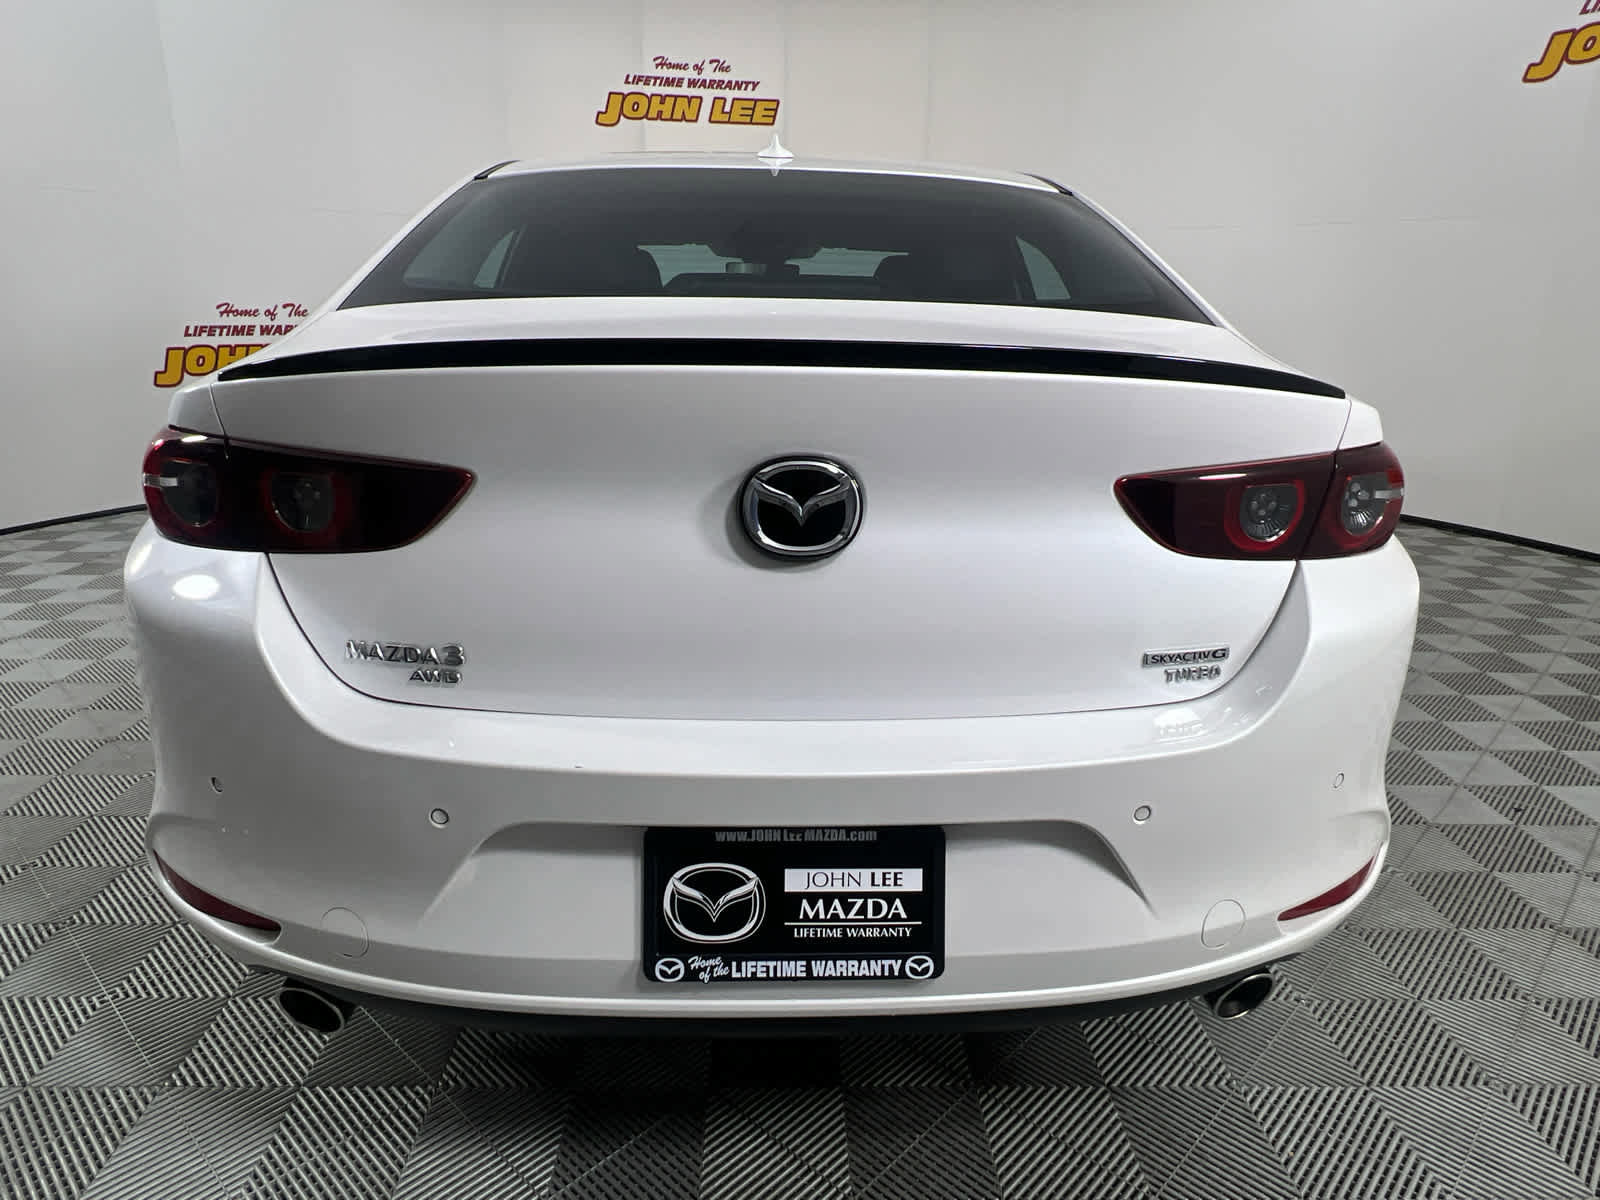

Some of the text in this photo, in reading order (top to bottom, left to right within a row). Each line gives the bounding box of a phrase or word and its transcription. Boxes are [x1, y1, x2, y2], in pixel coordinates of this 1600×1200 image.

[1522, 20, 1600, 83] JO
[653, 56, 732, 75] Home of The
[624, 74, 760, 92] LIFETIME WARRANTY
[595, 91, 780, 127] JOHN LEE
[216, 302, 309, 321] Home of The
[184, 325, 256, 337] LIFETIME
[154, 343, 273, 388] JOH
[408, 669, 461, 684] AWD
[805, 872, 904, 889] JOHN LEE
[800, 898, 907, 920] MAZDA
[794, 927, 912, 938] LIFETIME WARRANTY
[688, 956, 722, 970] Home
[699, 962, 730, 983] of the
[731, 959, 902, 978] LIFETIME WARRANTY
